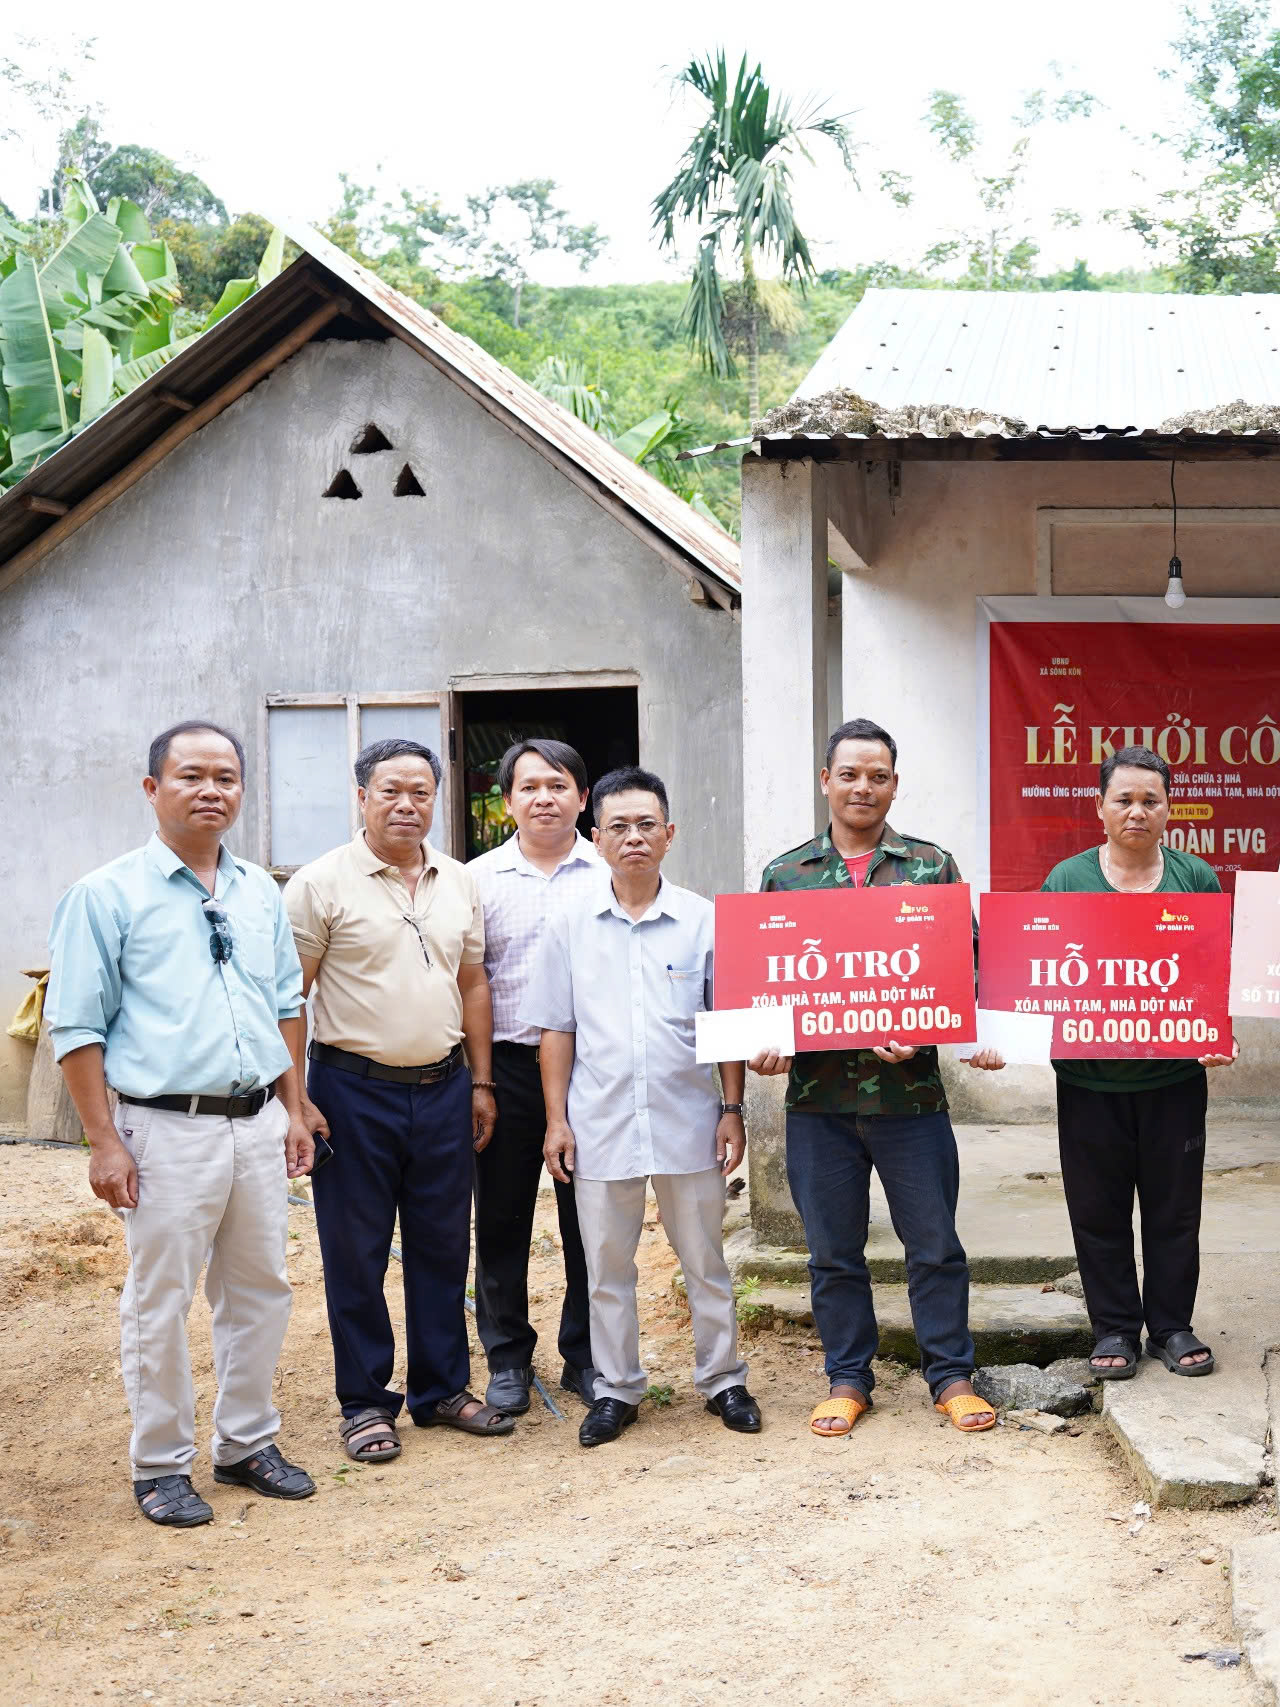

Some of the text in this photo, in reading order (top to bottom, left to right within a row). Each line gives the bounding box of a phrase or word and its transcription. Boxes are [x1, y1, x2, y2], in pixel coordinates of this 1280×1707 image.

[1052, 657, 1069, 665] UBND
[1024, 703, 1077, 765] LỄ
[1089, 712, 1208, 765] KHỞI
[1174, 771, 1241, 784] SỬA CHỮA 3 NHÀ
[1022, 785, 1051, 797] HƯỞNG
[1052, 785, 1070, 797] ỨNG
[1071, 786, 1101, 797] CHƯƠN
[1170, 787, 1185, 797] TAY
[1187, 785, 1203, 797] XÓA
[1205, 785, 1223, 797] NHÀ
[1224, 787, 1245, 799] TẠM,
[1247, 785, 1263, 797] NHÀ
[1223, 827, 1266, 854] FVG
[1224, 864, 1242, 872] 2025
[766, 938, 920, 983] HỖ TRỢ
[1029, 942, 1179, 993] HỖ TRỢ
[752, 985, 936, 1008] XÓA NHÀ TẠM, NHÀ DỘT NÁT
[1014, 996, 1193, 1014] XÓA NHÀ TẠM, NHÀ DỘT NÁT
[1240, 984, 1264, 1003] SỐ
[801, 1005, 961, 1036] 60.000.000Đ
[1062, 1018, 1219, 1043] 60.000.000Đ
